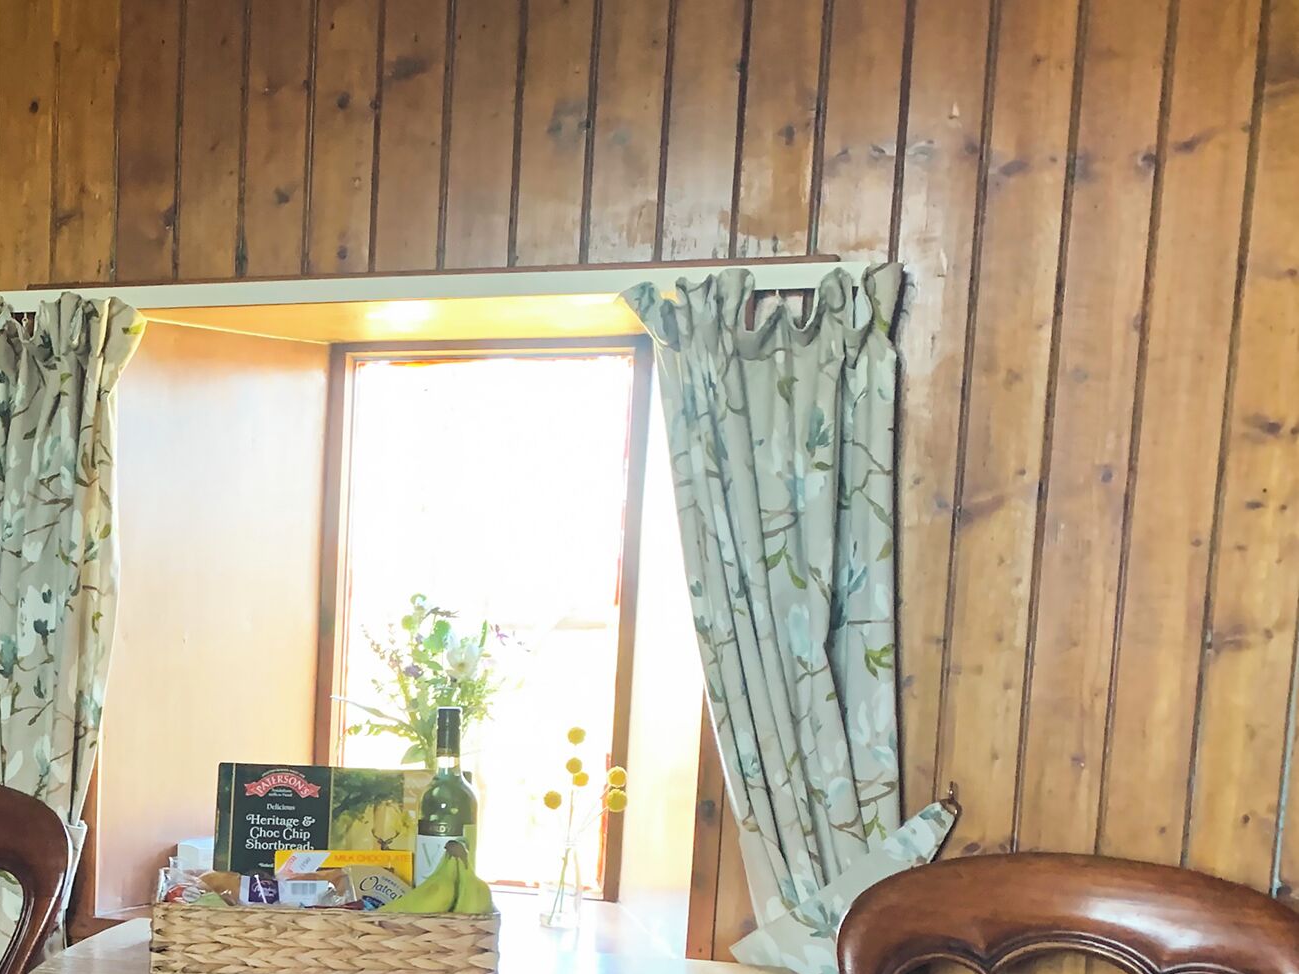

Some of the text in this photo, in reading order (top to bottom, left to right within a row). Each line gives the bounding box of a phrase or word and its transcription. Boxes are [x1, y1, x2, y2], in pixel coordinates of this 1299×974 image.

[256, 775, 310, 796] PATERSON'S
[266, 803, 295, 811] Delicious
[246, 813, 315, 828] Heritage &
[250, 826, 310, 841] Choc Chip
[245, 839, 314, 850] Shortbread
